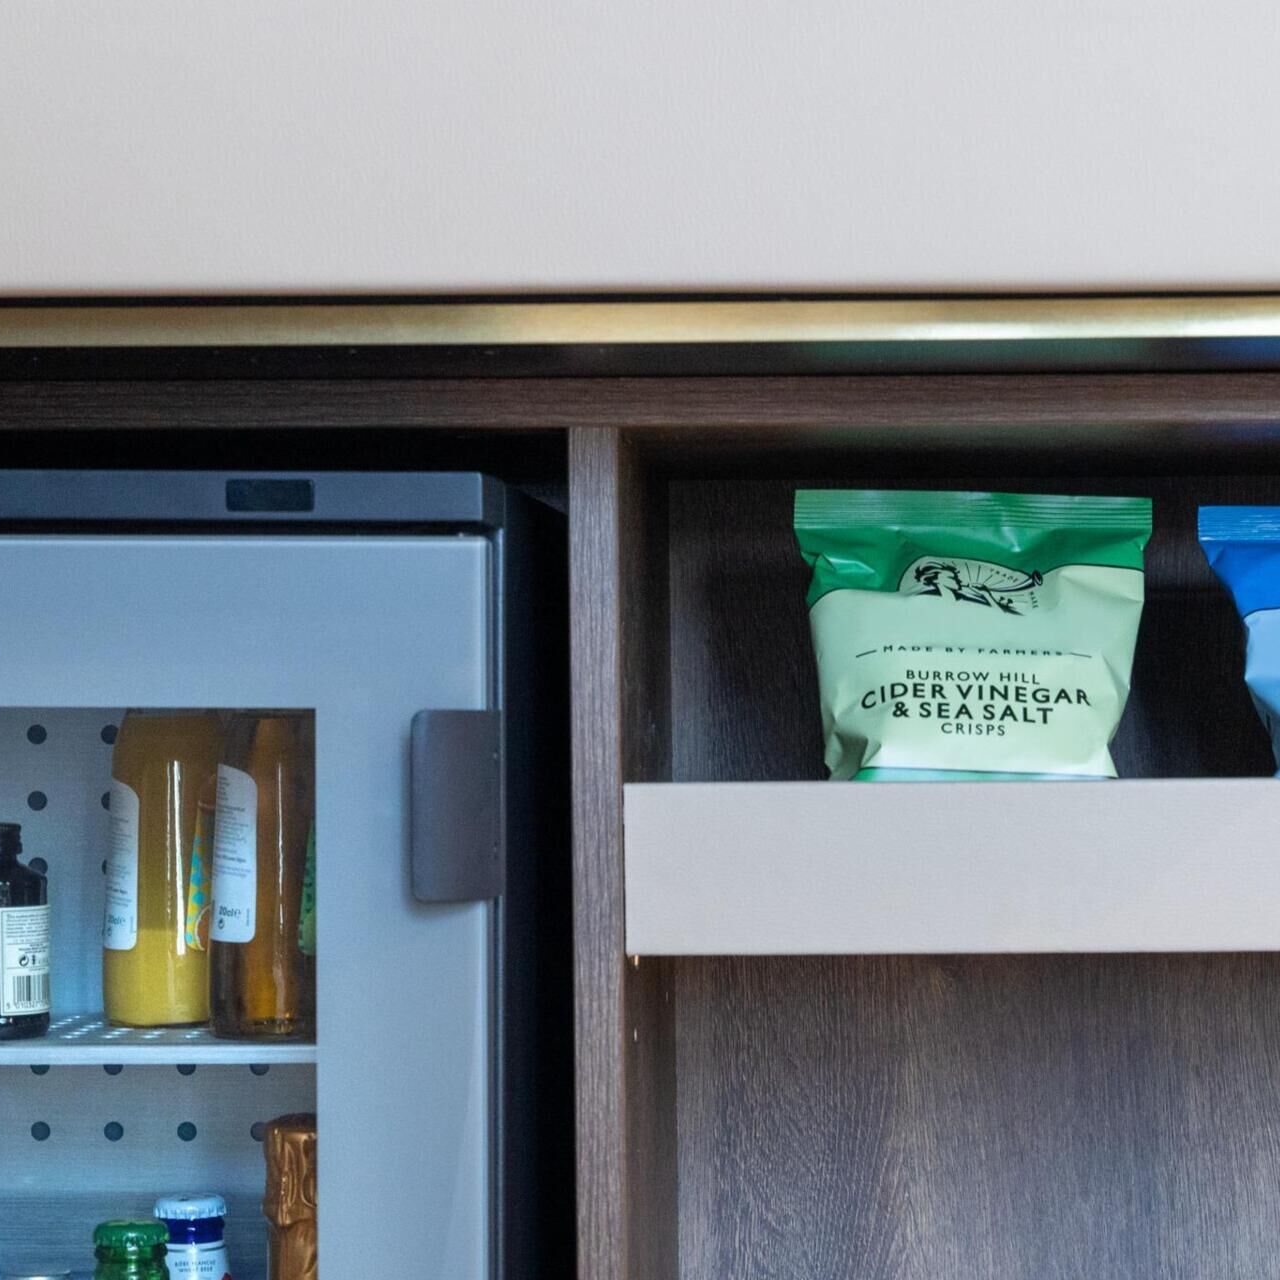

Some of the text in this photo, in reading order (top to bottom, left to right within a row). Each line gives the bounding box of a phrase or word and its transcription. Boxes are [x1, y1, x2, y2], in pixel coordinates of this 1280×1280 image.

[883, 644, 933, 653] MADE
[978, 647, 1063, 657] FARMERS
[906, 669, 1041, 685] BURROW HILL
[860, 682, 1092, 709] CIDER VINEGAR
[892, 701, 1054, 725] & SEA SALT
[940, 722, 1006, 737] CRISPS
